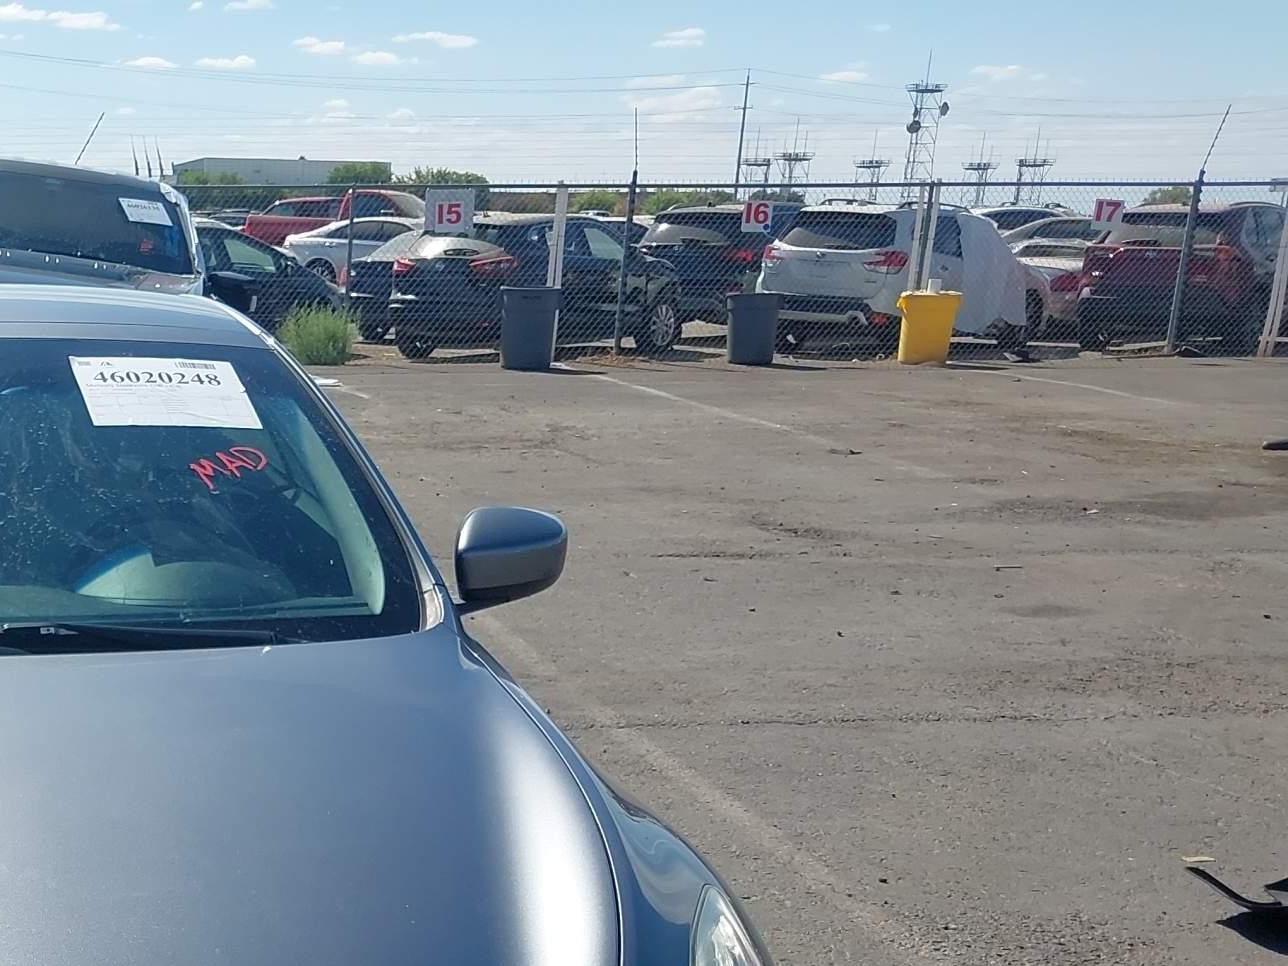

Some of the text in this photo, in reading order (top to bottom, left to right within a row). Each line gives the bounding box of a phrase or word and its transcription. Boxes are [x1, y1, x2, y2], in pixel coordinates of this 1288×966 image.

[437, 203, 462, 225] 15
[744, 202, 770, 225] 16
[1095, 200, 1122, 222] 17
[93, 371, 222, 387] 46020248
[188, 446, 267, 490] MAD
